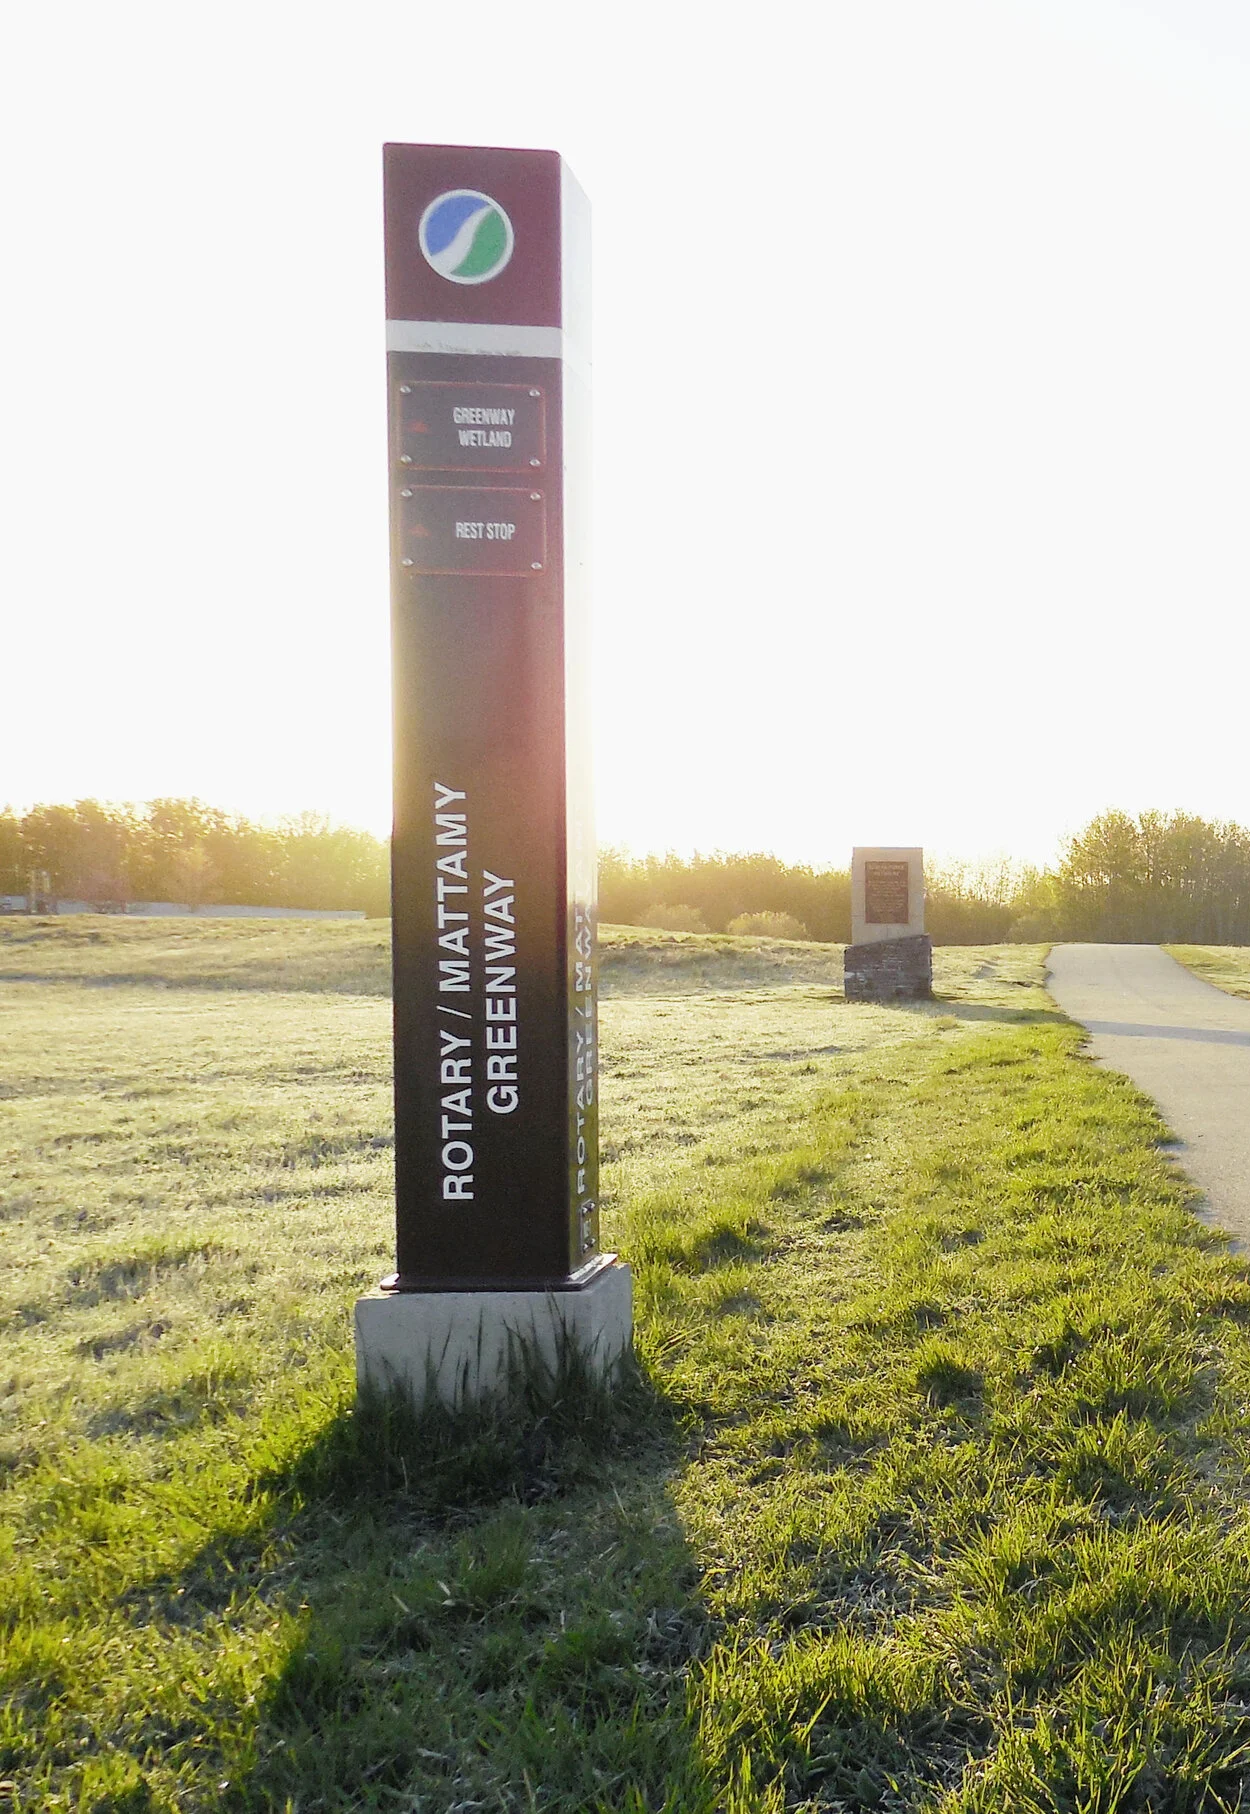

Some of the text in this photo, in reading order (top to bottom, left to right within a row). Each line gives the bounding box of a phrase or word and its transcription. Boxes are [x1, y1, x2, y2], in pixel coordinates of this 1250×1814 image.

[453, 406, 515, 425] GREENWAY
[458, 429, 512, 448] WETLAND
[456, 522, 516, 540] REST STOP
[434, 781, 474, 1200] ROTARY / MATTAMY
[483, 869, 519, 1115] GREENWAY
[575, 1031, 585, 1195] ROTARY
